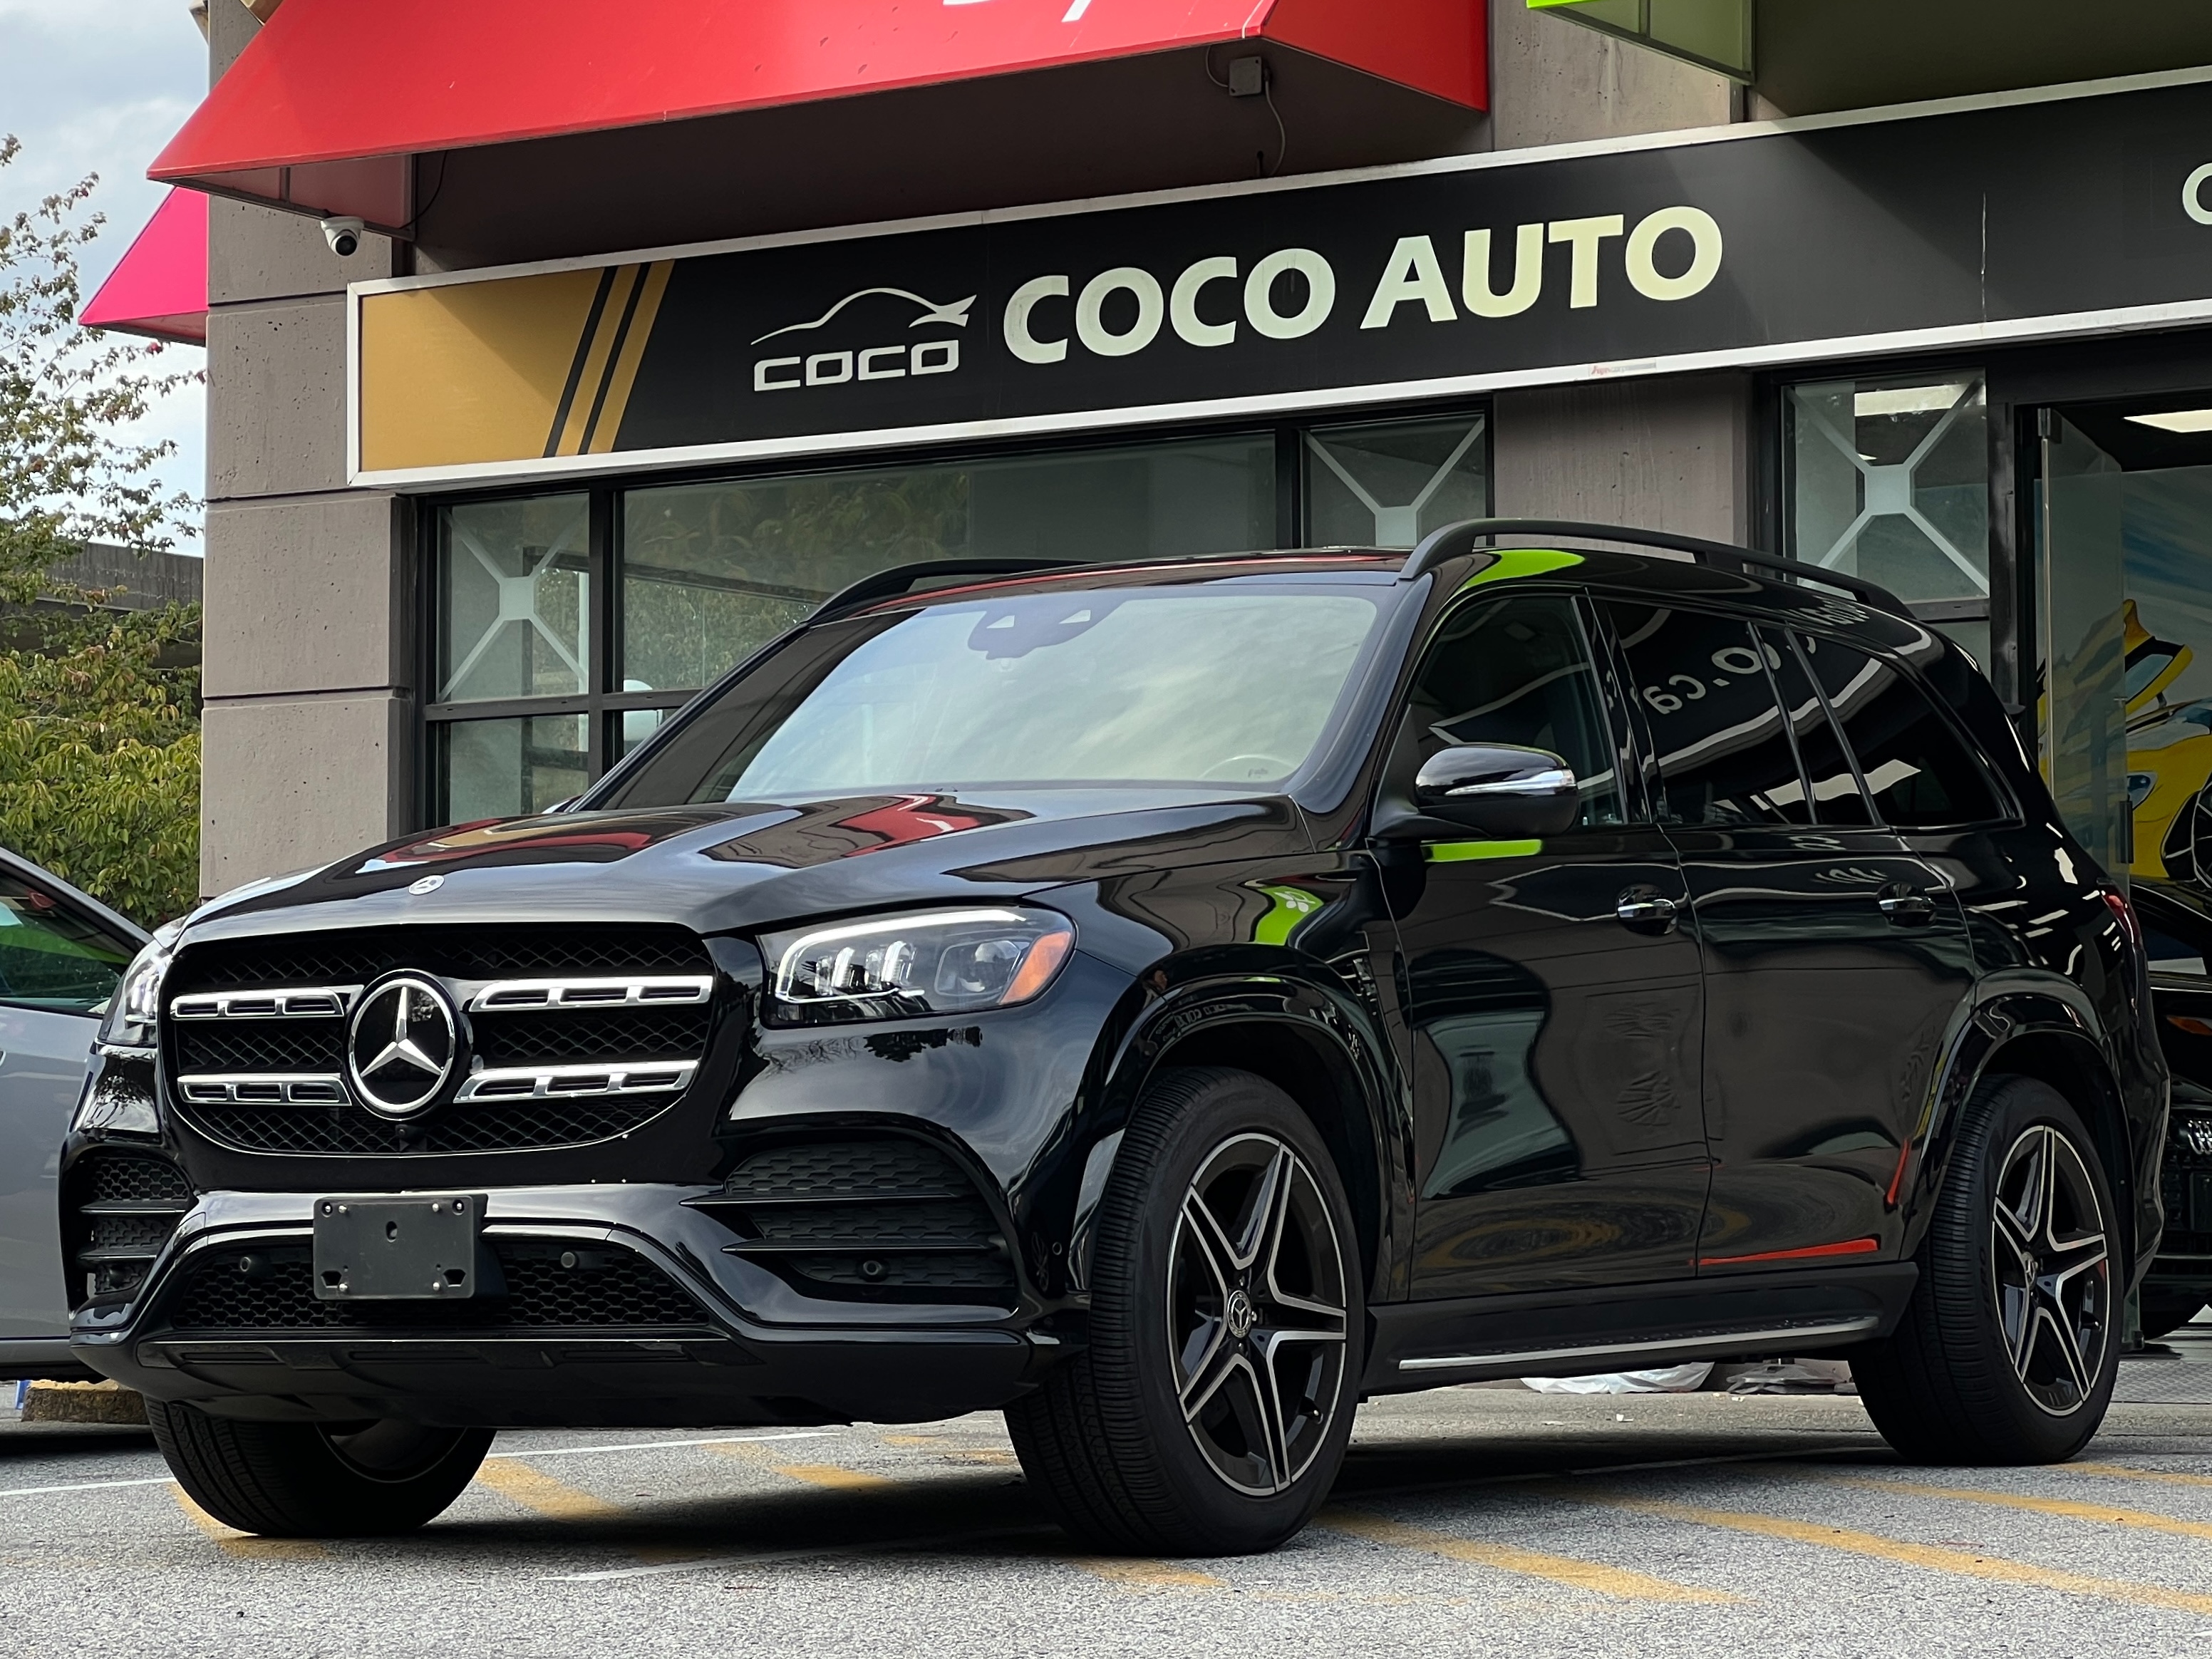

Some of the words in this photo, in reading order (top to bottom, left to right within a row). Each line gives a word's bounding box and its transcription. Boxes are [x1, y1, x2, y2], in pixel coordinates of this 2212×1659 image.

[1003, 248, 1336, 364] COCO
[1360, 205, 1724, 329] AUTO
[754, 339, 960, 392] COCO
